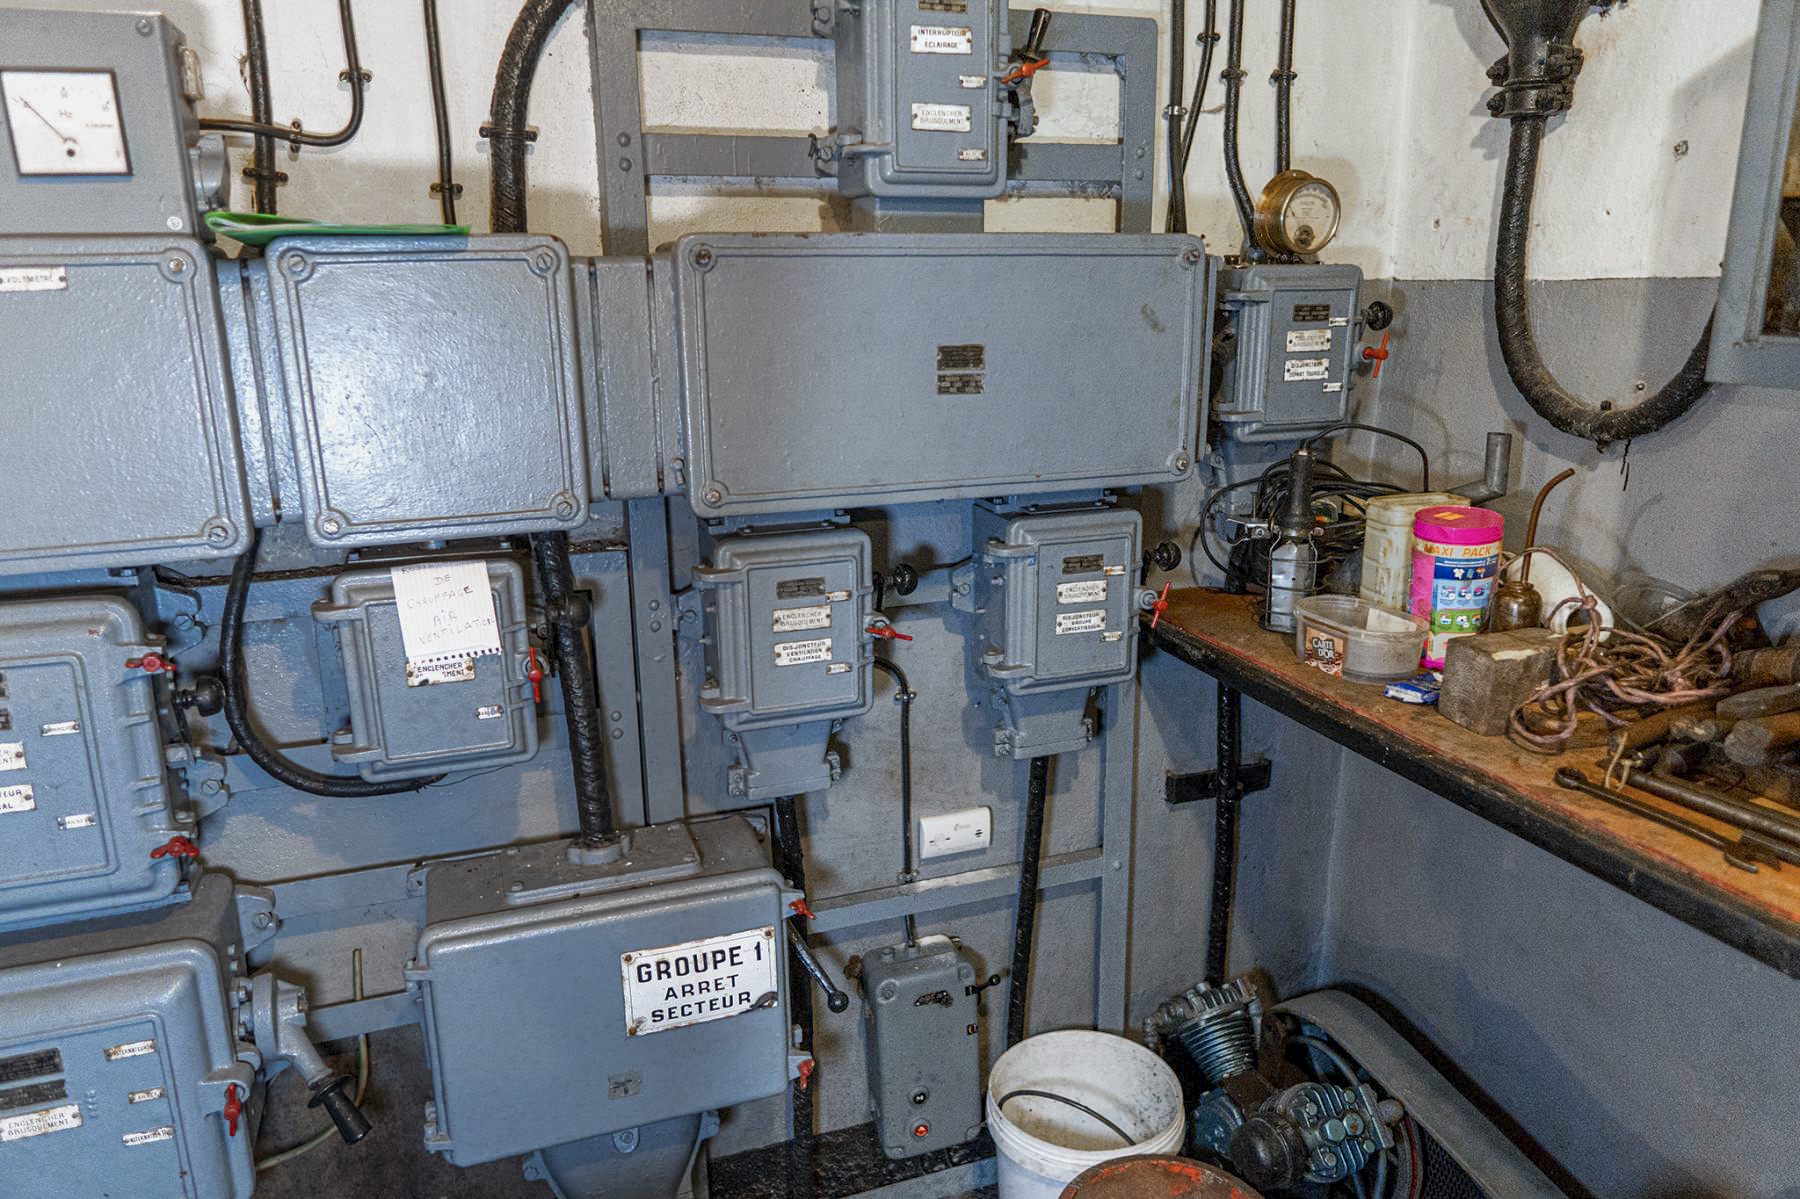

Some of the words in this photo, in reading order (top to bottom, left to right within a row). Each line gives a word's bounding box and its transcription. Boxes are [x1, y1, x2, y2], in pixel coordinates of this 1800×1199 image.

[924, 41, 958, 49] ECLAIRAGE
[921, 109, 963, 117] ENCLENCHER
[1424, 543, 1453, 557] MAXI
[1462, 545, 1491, 557] PACK
[783, 641, 826, 650] DISJONCTEUR
[1312, 637, 1333, 650] CARTE
[786, 649, 822, 657] VENTILATION
[1318, 648, 1335, 658] D'OR
[417, 662, 463, 673] ENCLENCHER
[637, 945, 743, 983] GROUPE
[754, 941, 762, 961] 1
[665, 974, 739, 1001] ARRET
[652, 991, 751, 1023] SECTEUR
[8, 1118, 69, 1136] BRUSQUEMENT
[9, 1112, 65, 1129] ENCLENCHER
